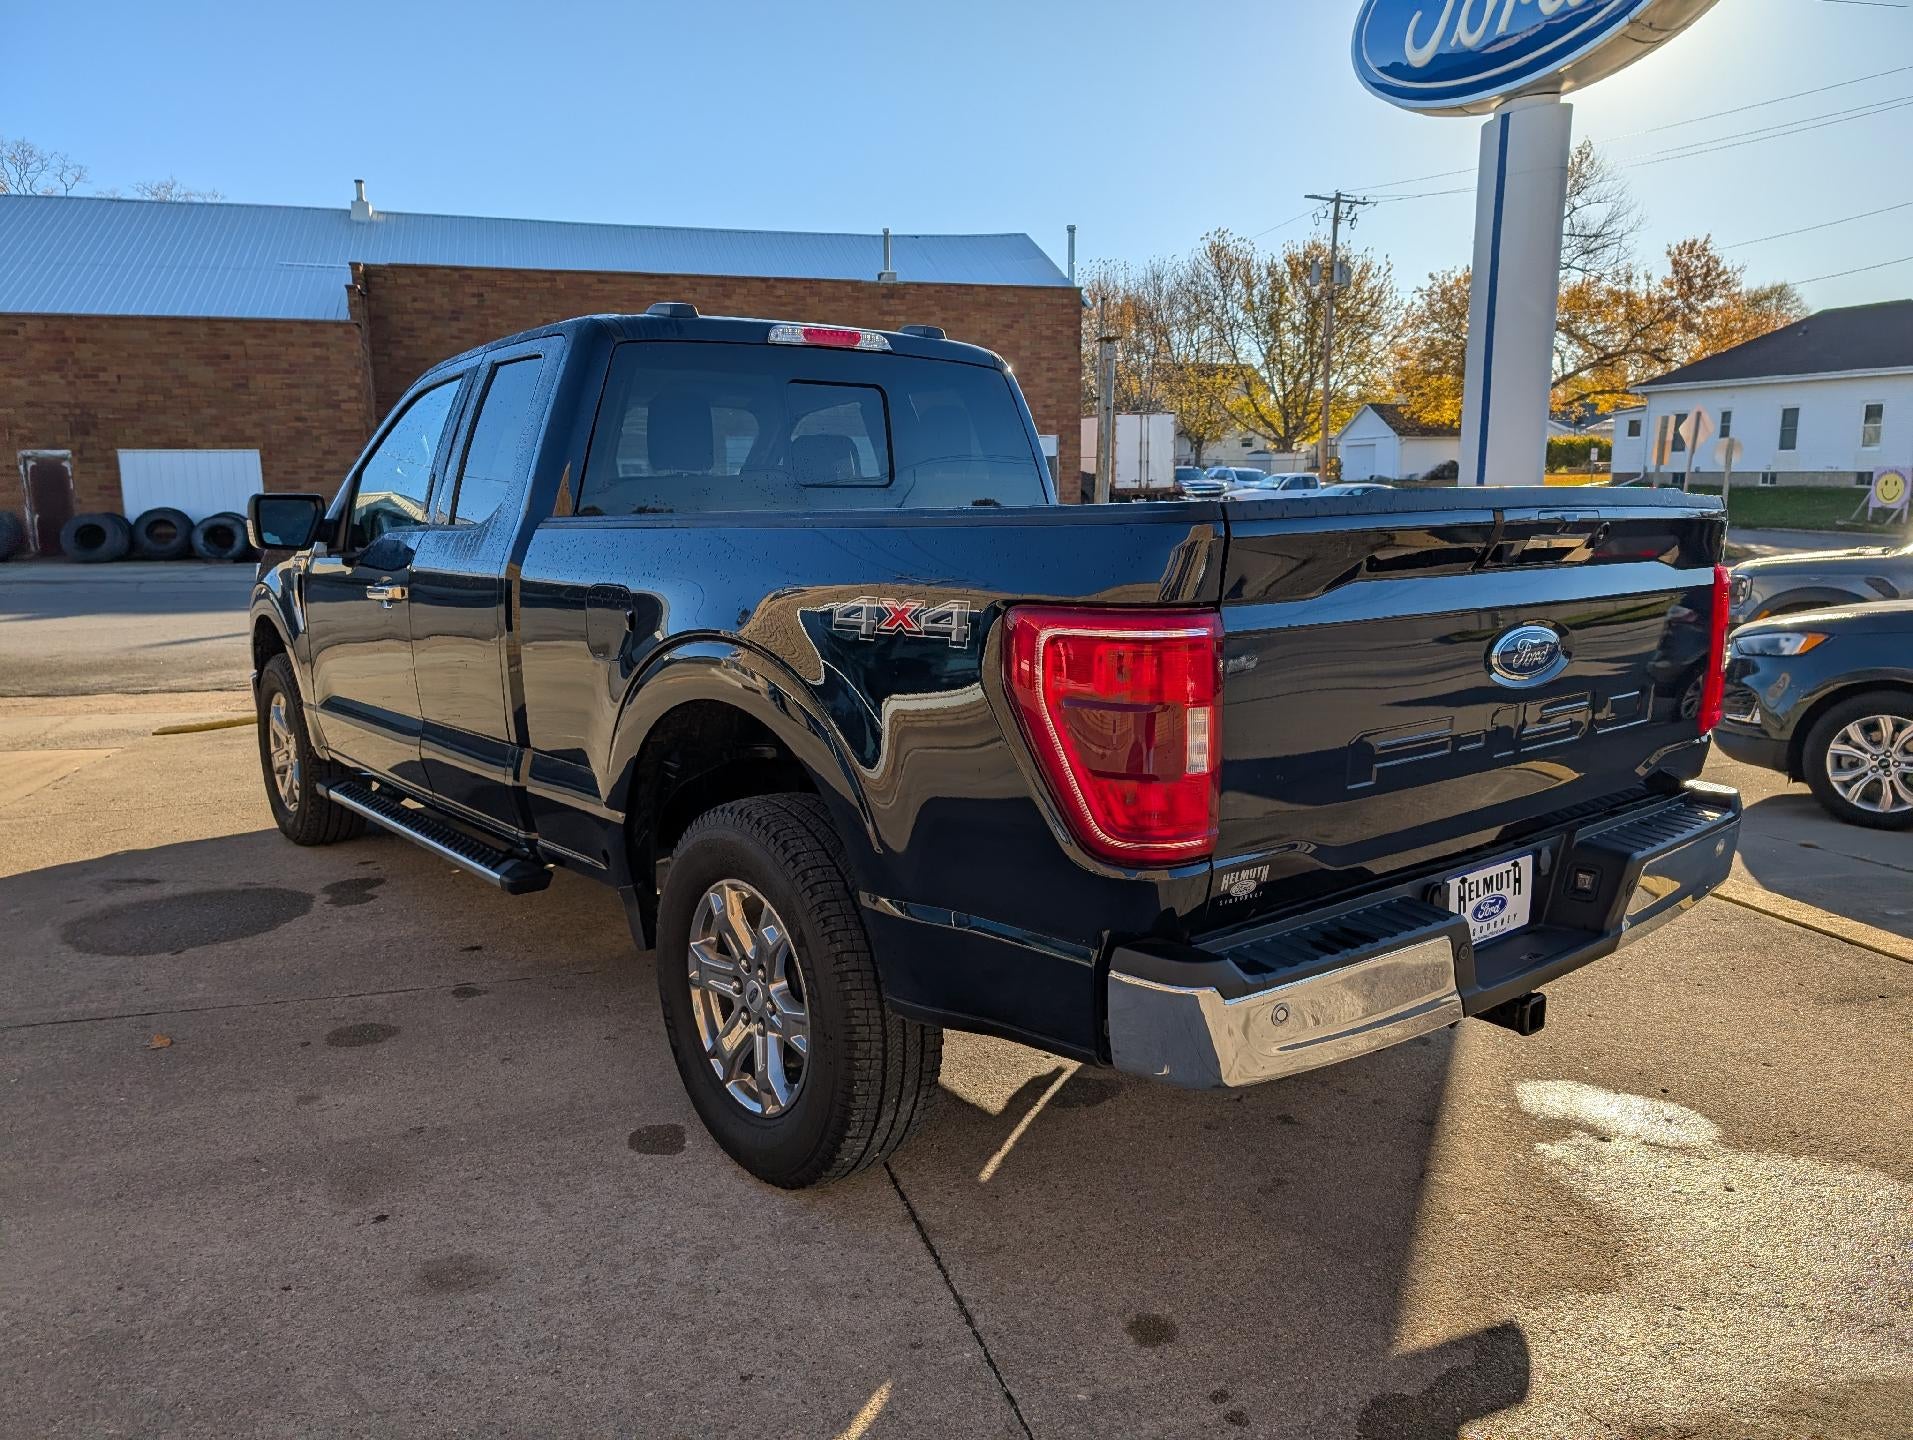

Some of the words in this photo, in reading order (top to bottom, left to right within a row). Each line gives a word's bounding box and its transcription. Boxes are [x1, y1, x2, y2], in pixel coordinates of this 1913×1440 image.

[1512, 638, 1552, 669] Ford
[1220, 864, 1270, 892] HELMUTH
[1457, 862, 1522, 916] HELMUTH
[1477, 898, 1502, 919] Ford
